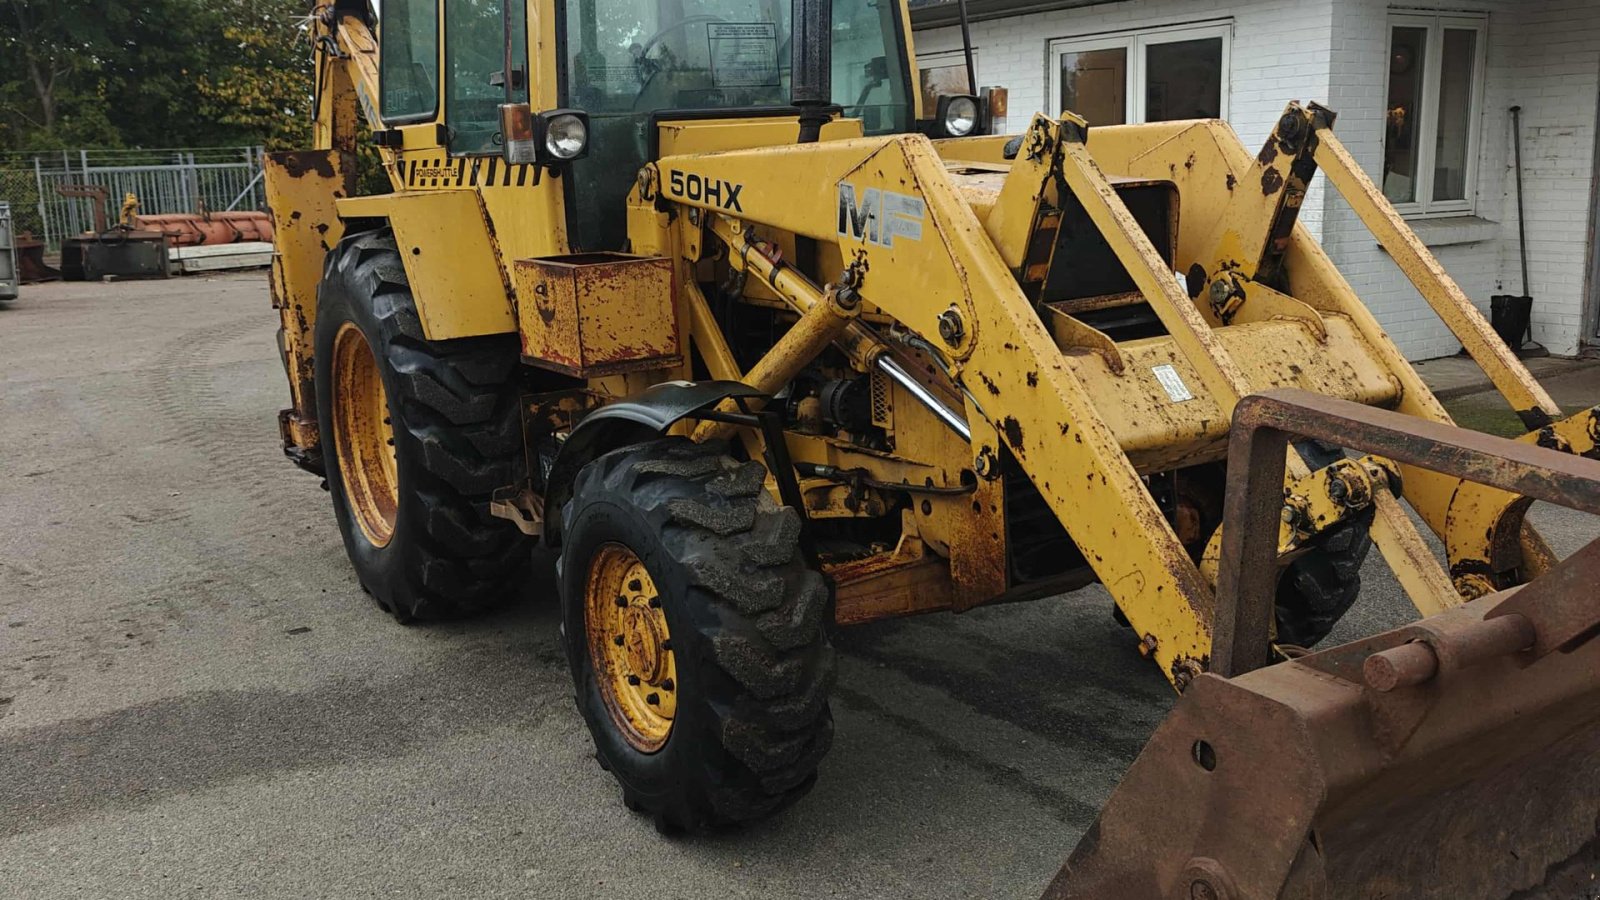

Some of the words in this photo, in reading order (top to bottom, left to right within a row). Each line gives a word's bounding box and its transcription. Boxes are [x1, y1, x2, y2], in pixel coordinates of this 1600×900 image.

[416, 168, 458, 178] POWERSHUTTLE
[671, 169, 743, 213] 50HX
[838, 182, 924, 248] MF
